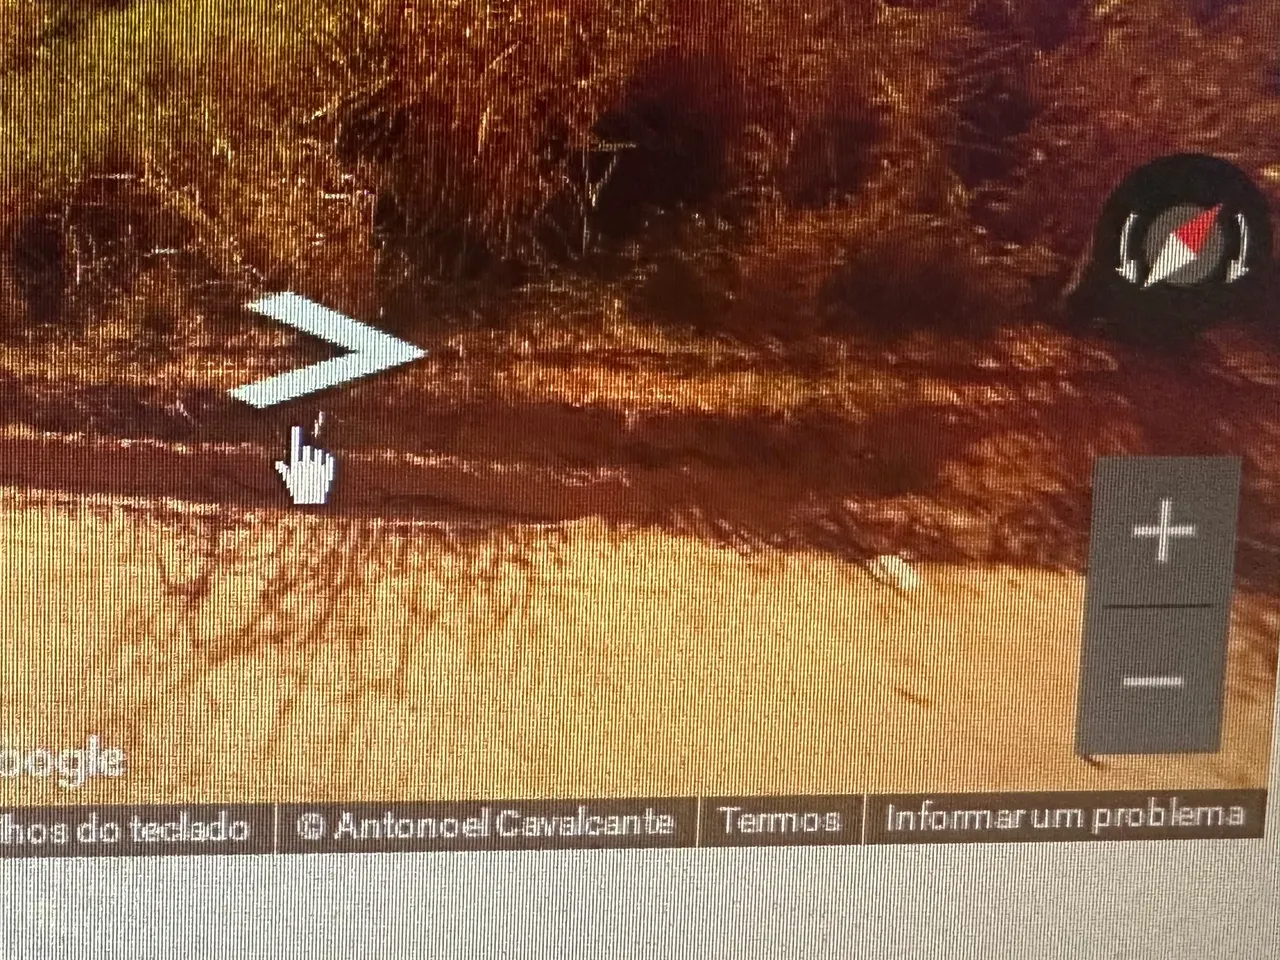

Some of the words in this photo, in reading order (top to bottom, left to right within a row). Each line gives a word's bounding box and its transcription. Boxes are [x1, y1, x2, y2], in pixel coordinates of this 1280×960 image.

[77, 814, 117, 844] do
[128, 809, 250, 843] teclado
[334, 805, 489, 841] Antonoel
[495, 805, 676, 838] Cavalcante
[719, 804, 842, 835] Termos
[886, 800, 1025, 834] Informar
[1032, 807, 1083, 831] um
[1091, 795, 1247, 836] problema
